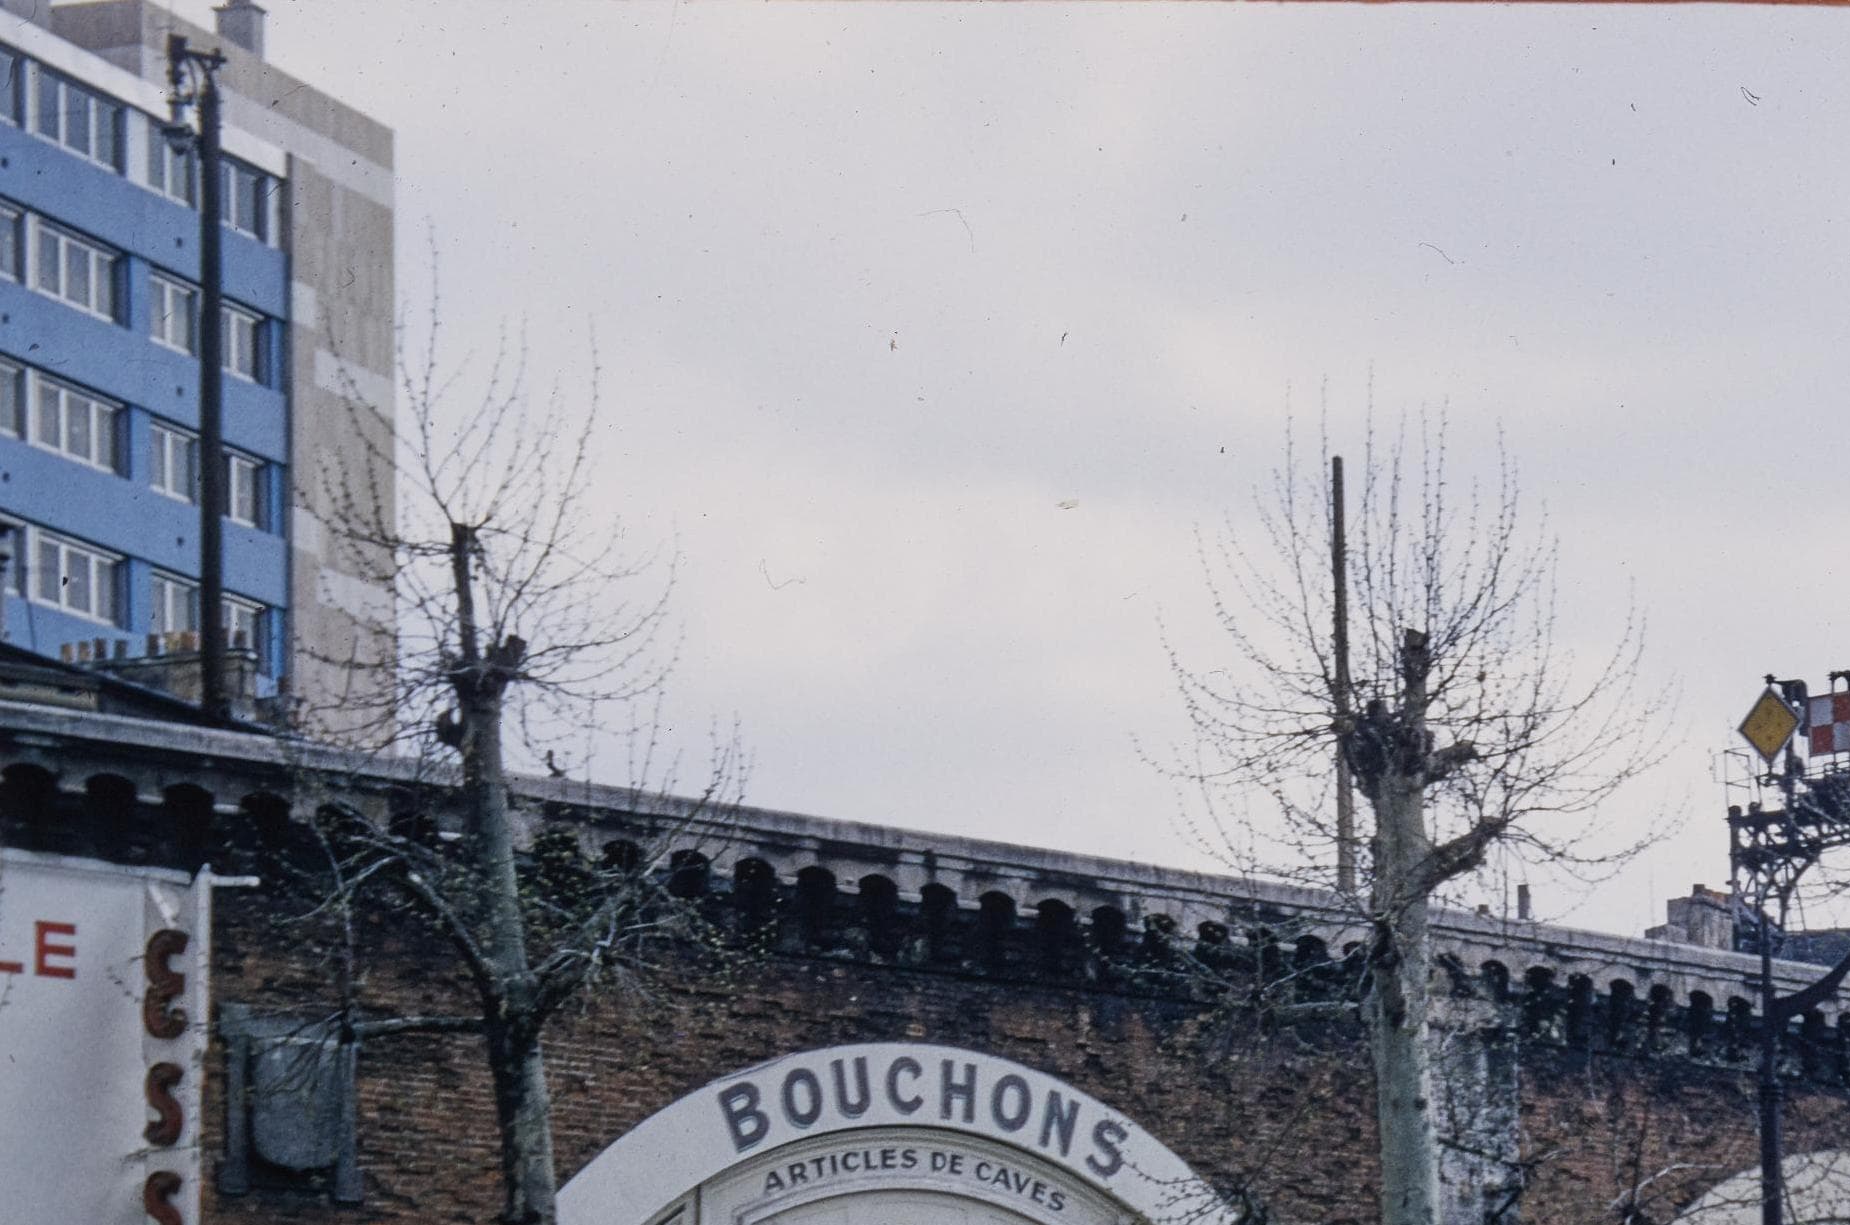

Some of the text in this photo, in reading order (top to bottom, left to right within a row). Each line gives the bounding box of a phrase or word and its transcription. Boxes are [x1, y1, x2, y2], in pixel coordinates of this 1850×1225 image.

[718, 1056, 1129, 1178] BOUCHONS
[762, 1149, 1066, 1212] ARTICLES DE CAVES
